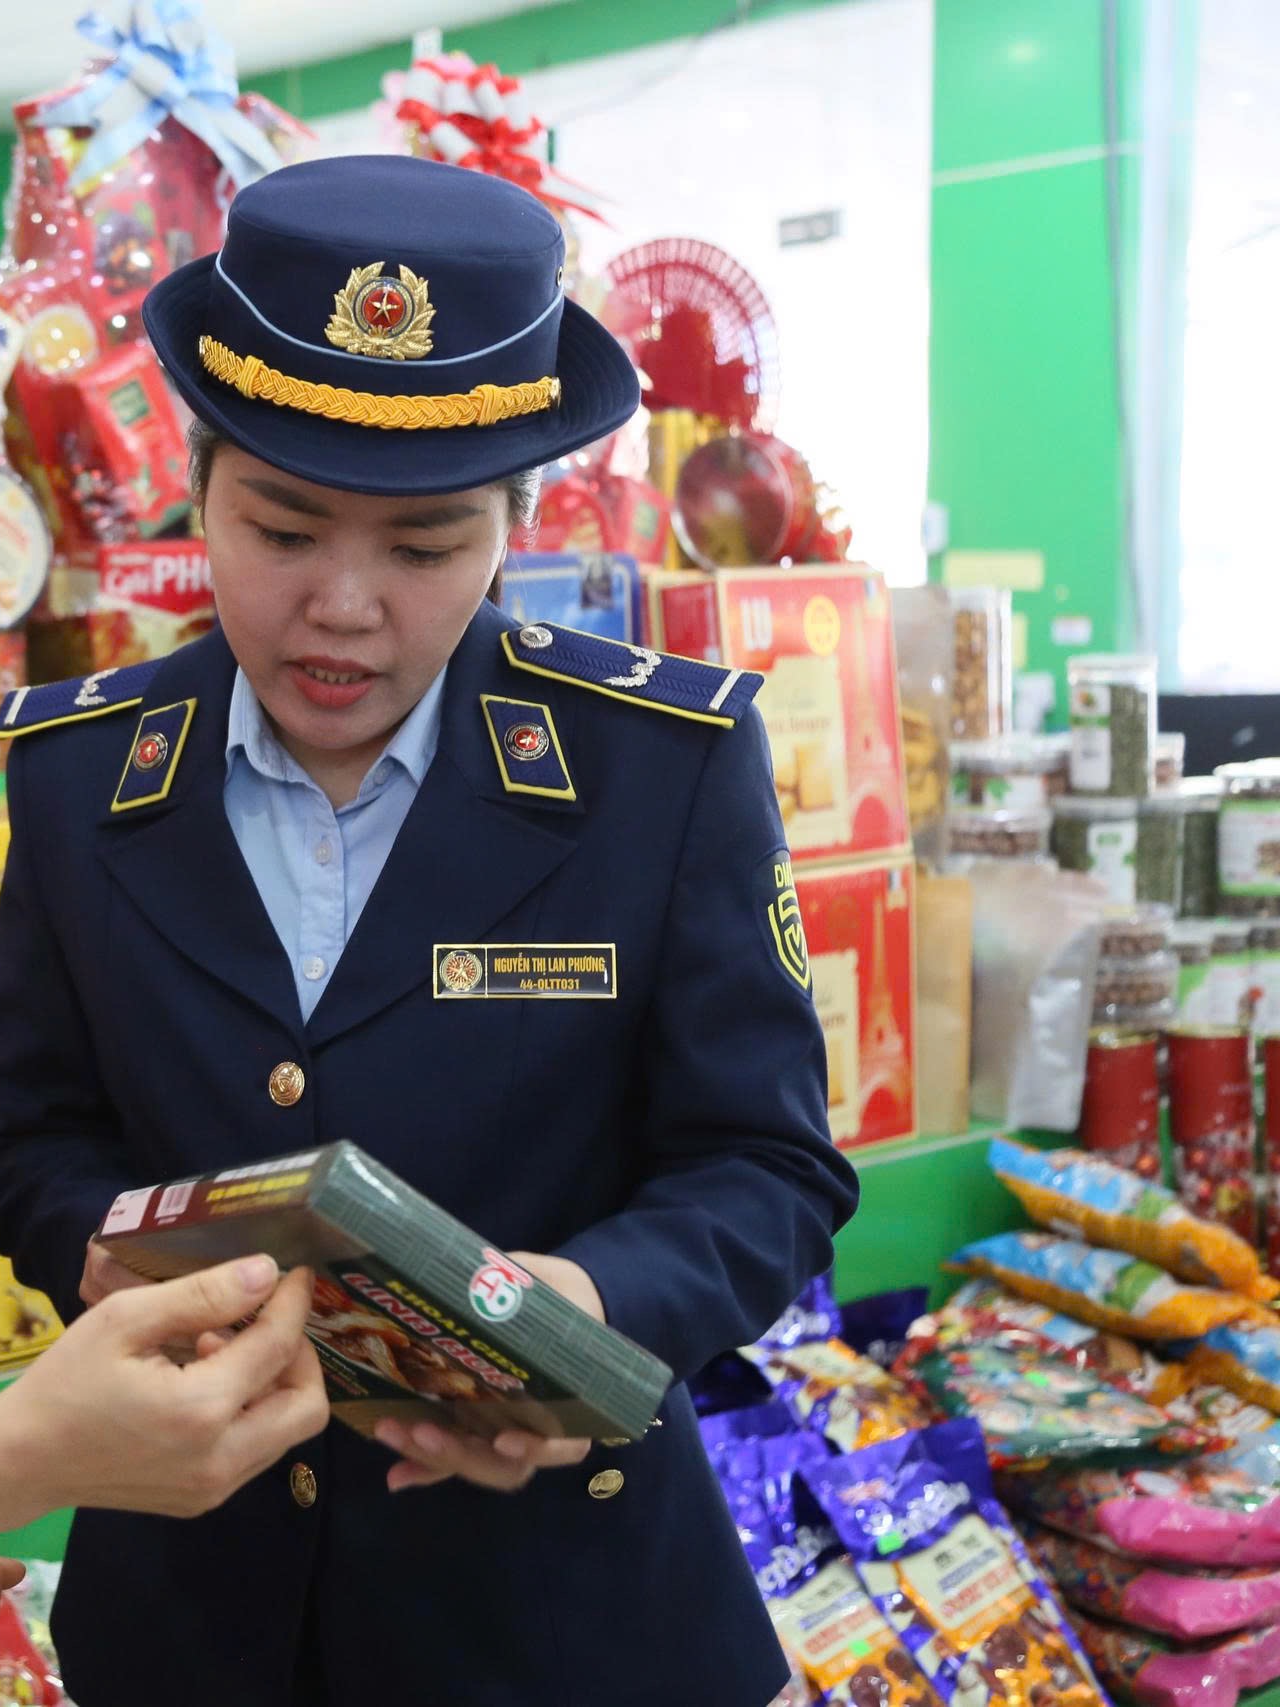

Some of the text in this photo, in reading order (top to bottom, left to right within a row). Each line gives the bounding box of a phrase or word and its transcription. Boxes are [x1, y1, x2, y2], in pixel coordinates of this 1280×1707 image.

[494, 951, 529, 973] NGUYỄN
[531, 957, 547, 976] THỊ
[548, 957, 566, 973] LAN
